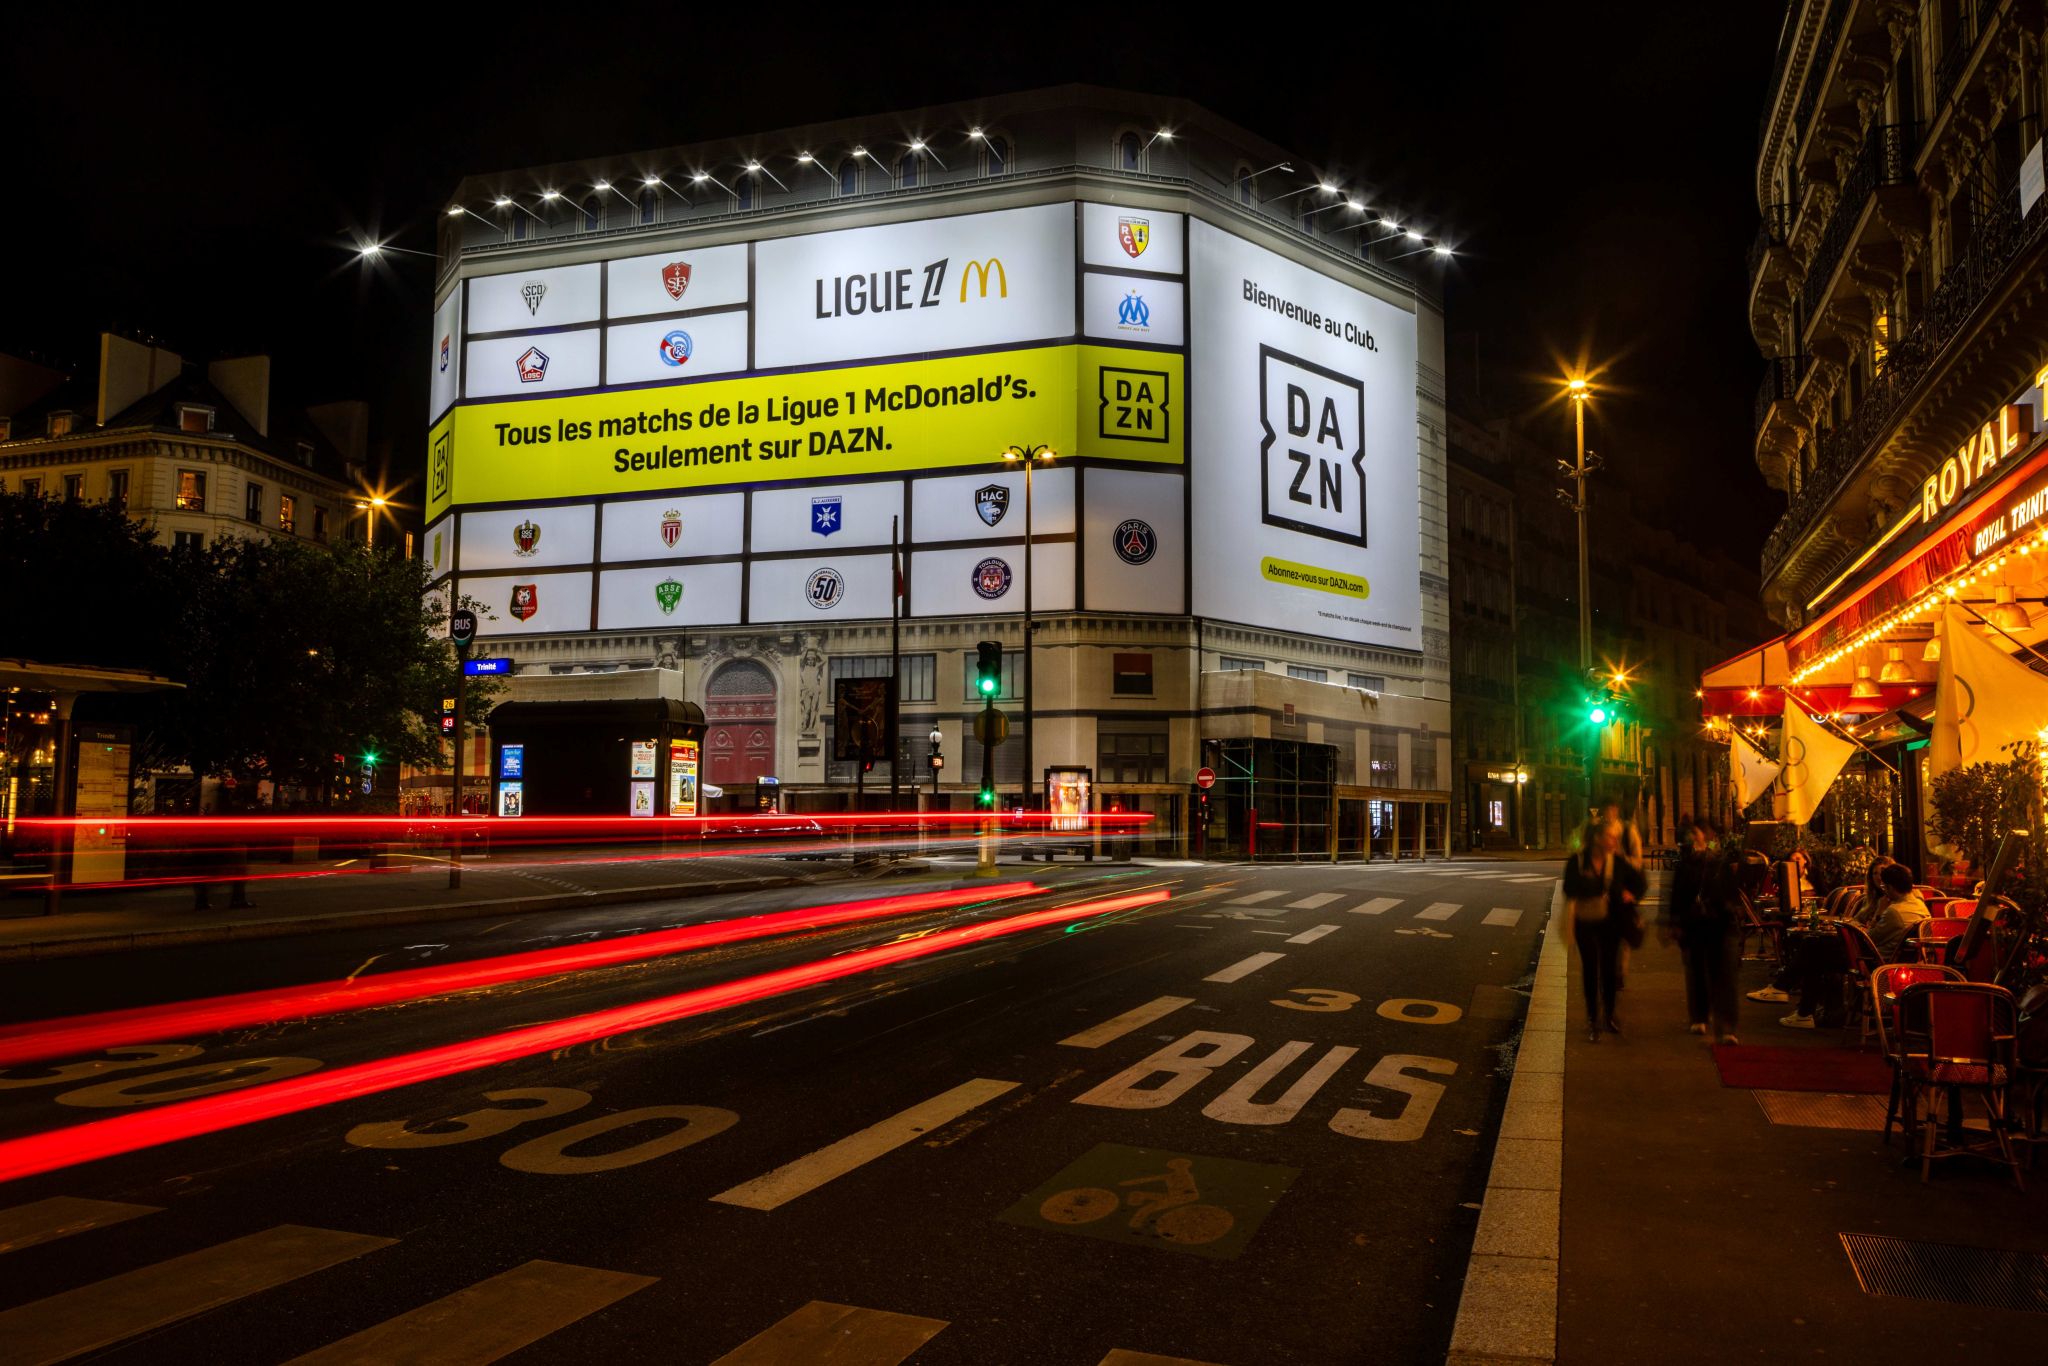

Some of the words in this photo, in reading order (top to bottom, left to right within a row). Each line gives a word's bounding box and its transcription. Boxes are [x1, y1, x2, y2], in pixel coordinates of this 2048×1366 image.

[525, 284, 543, 296] SCO
[816, 268, 913, 319] LIGUE
[1243, 278, 1321, 330] Bienvenue
[1324, 318, 1341, 338] au
[1345, 322, 1378, 353] Club.
[494, 423, 552, 447] Tous
[557, 419, 592, 442] les
[598, 408, 693, 438] matchs
[699, 403, 730, 429] de
[737, 400, 759, 424] la
[767, 395, 839, 426] Ligue
[845, 391, 855, 415] 1
[614, 438, 752, 473] Seulement
[758, 438, 802, 461] sur
[809, 425, 892, 456] DAZN.
[1922, 403, 2018, 524] ROYAL
[981, 491, 1004, 501] HAC
[1121, 522, 1150, 534] PARIS
[1975, 515, 2007, 555] ROYAL
[979, 559, 1005, 570] TOULOUSE
[1268, 563, 1318, 584] Abonnez-vous
[1318, 576, 1329, 586] sur
[1329, 576, 1364, 593] DAZN.com
[658, 584, 681, 593] ASSE
[812, 577, 837, 601] 50
[454, 619, 471, 630] BUS
[476, 662, 497, 671] Trinité
[444, 719, 453, 728] 43
[1269, 988, 1463, 1025] 30
[1070, 1029, 1459, 1142] BUS
[345, 1086, 740, 1175] 30
